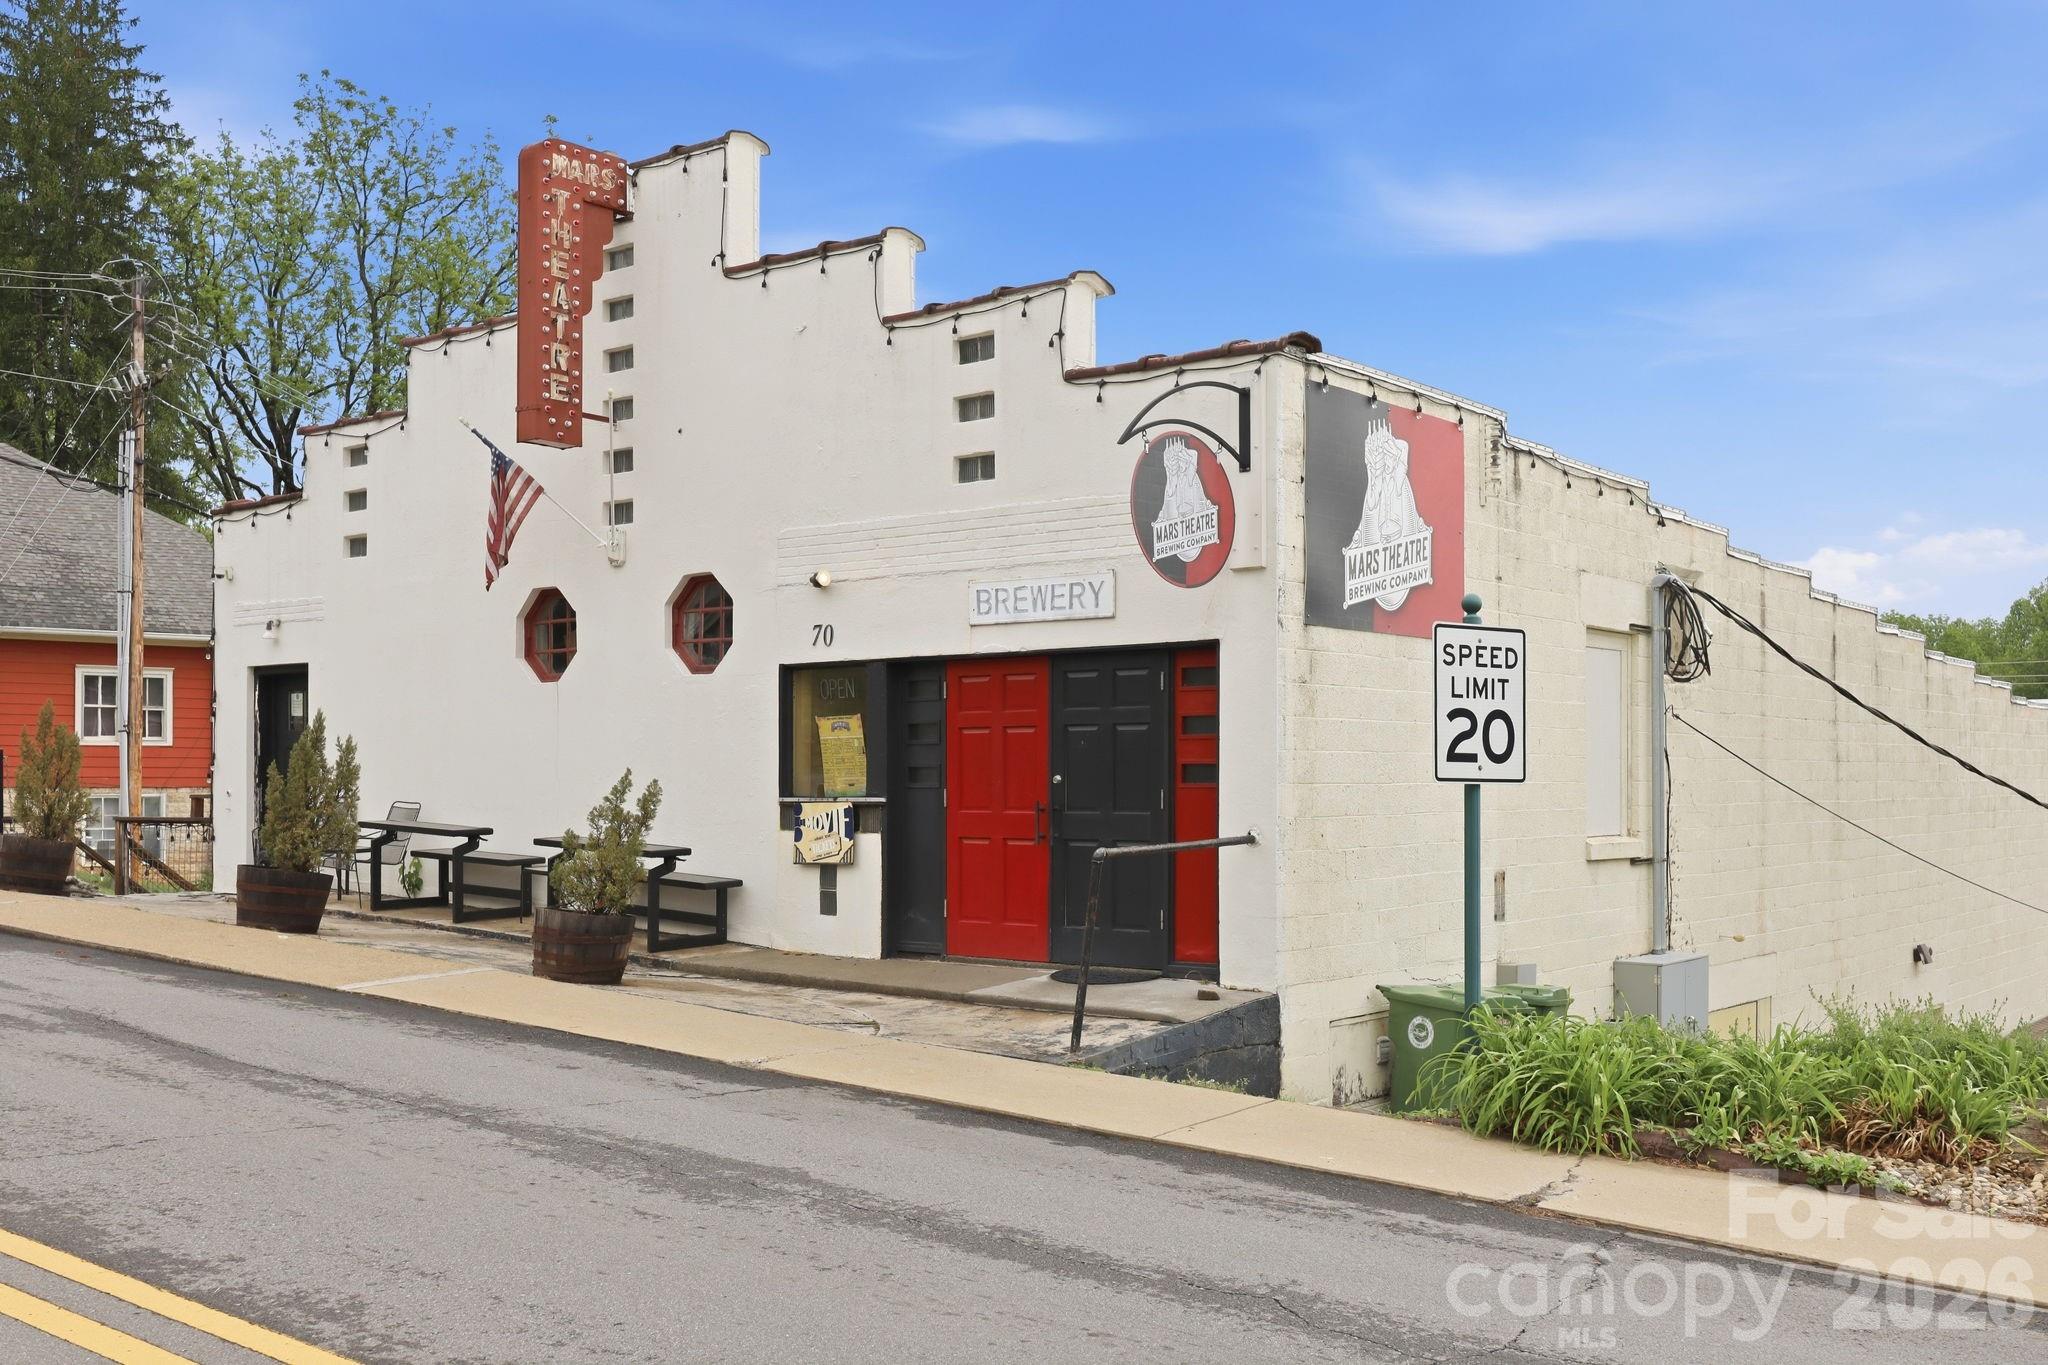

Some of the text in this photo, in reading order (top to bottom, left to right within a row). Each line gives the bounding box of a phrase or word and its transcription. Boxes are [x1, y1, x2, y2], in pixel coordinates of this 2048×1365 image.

[552, 152, 616, 190] MARS
[550, 187, 571, 401] THEATRE
[1156, 512, 1215, 544] MARS THEATRE
[1156, 532, 1216, 557] BREWING COMPANY
[1348, 536, 1428, 581] MARS THEATRE
[976, 580, 1105, 616] BREWERY
[1348, 567, 1428, 601] BREWING COMPANY
[812, 624, 834, 647] 70
[1442, 643, 1518, 669] SPEED
[819, 678, 856, 700] OPEN
[1451, 676, 1509, 700] LIMIT
[1446, 707, 1515, 764] 20
